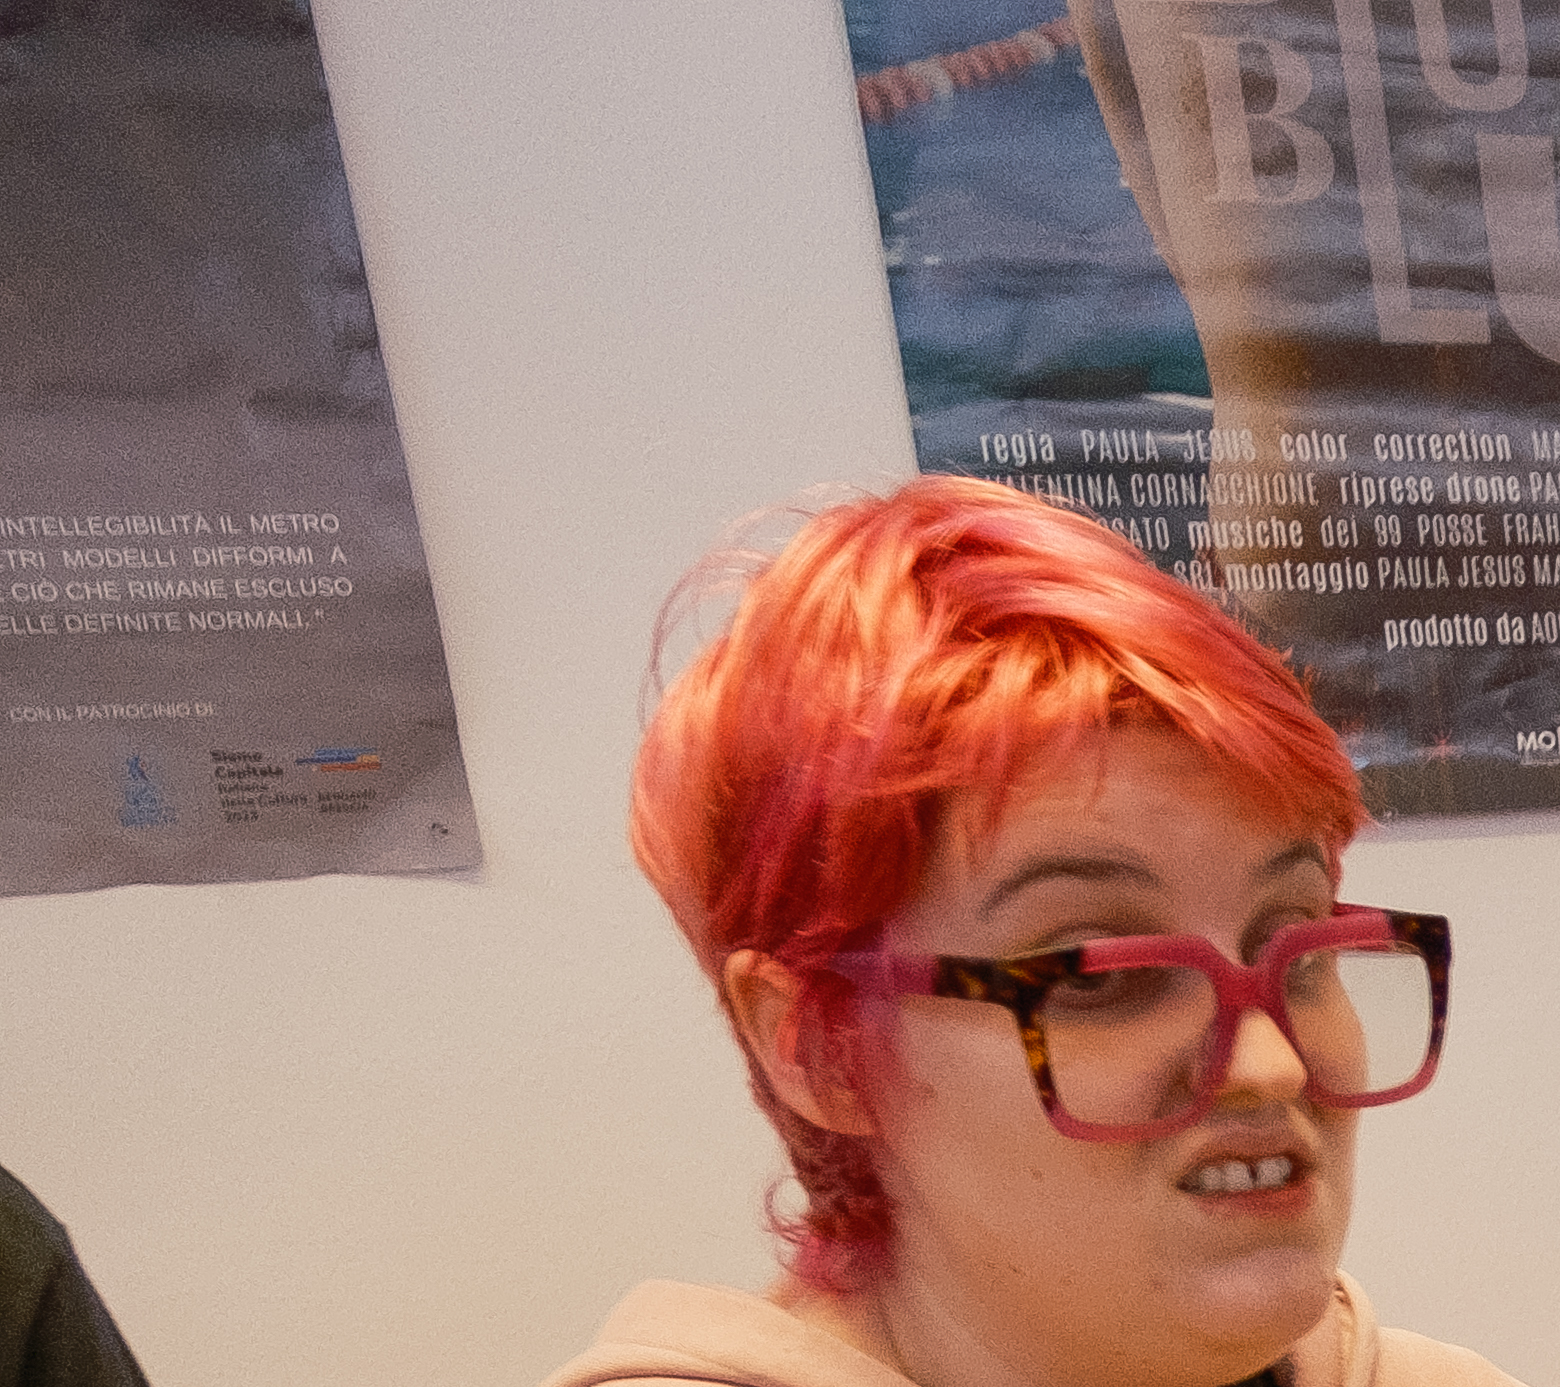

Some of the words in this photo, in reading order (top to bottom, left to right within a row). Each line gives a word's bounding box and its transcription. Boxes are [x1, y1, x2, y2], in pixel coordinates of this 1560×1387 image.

[979, 429, 1056, 467] regia
[1081, 429, 1158, 463] PAULA
[1184, 428, 1256, 463] JESUS
[1280, 428, 1348, 462] color
[1373, 429, 1512, 462] correction
[986, 473, 1122, 507] ENTINA
[1131, 472, 1318, 507] CORNACCHIONE
[1339, 472, 1434, 510] riprese
[1446, 471, 1521, 503] drone
[220, 514, 242, 535] IL
[252, 513, 339, 535] METRO
[1188, 516, 1304, 551] musiche
[1321, 515, 1368, 548] dei
[1374, 515, 1402, 547] 99
[1418, 514, 1486, 546] POSSE
[1503, 513, 1560, 546] FRAH
[62, 547, 177, 570] MODELLI
[192, 545, 314, 568] DIFFORMI
[331, 545, 349, 566] A
[66, 580, 122, 601] CHE
[128, 577, 228, 601] RIMANE
[234, 576, 353, 600] ESCLUSO
[1226, 560, 1369, 594] montaggio
[1377, 556, 1449, 589] PAULA
[1459, 555, 1525, 588] JESUS
[65, 610, 182, 635] DEFINITE
[1384, 614, 1487, 651] prodotto
[1497, 612, 1525, 647] da
[10, 705, 52, 723] CON
[56, 705, 73, 721] IL
[76, 702, 191, 720] PATROCINIO
[195, 702, 214, 717] DI
